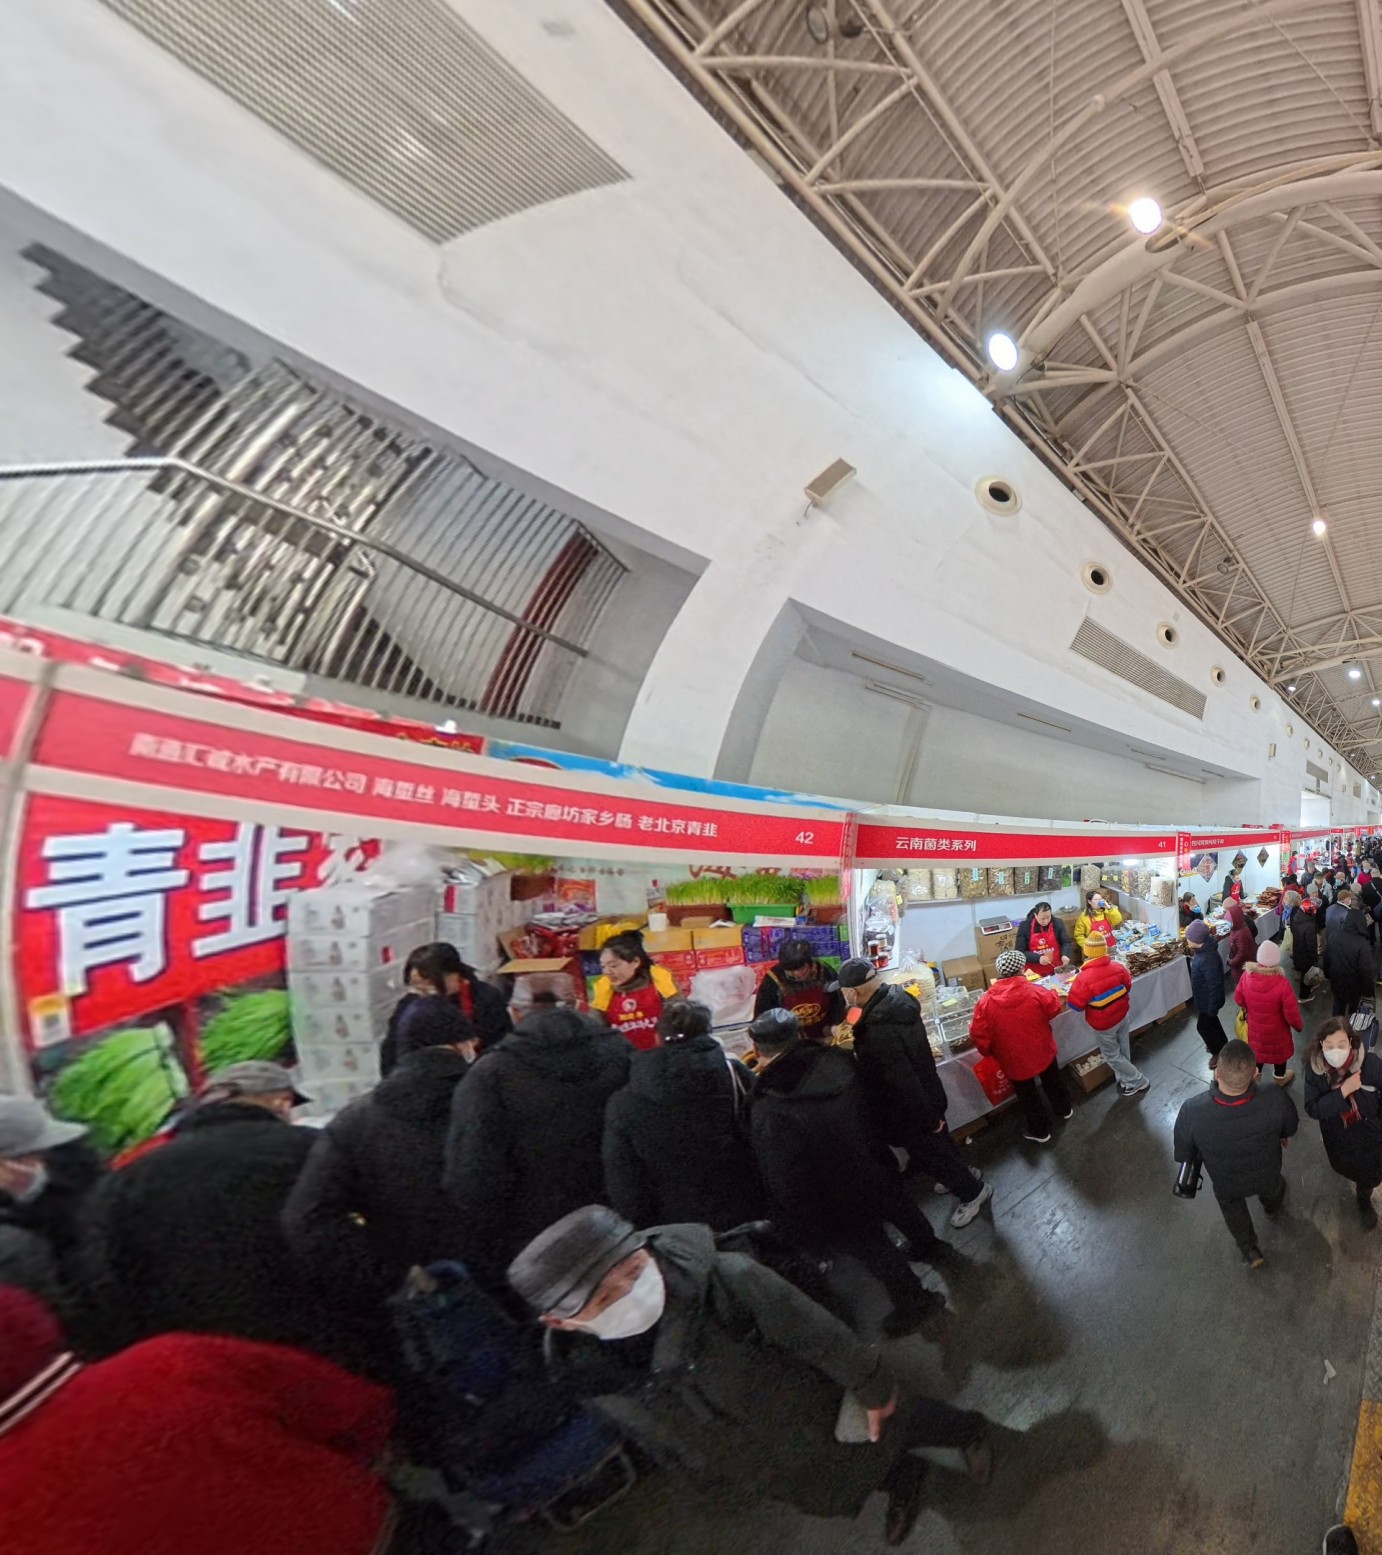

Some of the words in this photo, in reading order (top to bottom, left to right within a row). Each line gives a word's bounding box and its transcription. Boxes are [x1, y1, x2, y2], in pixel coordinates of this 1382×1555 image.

[795, 831, 814, 844] 42
[895, 836, 977, 852] 云南菌类系列
[1158, 840, 1167, 848] 41
